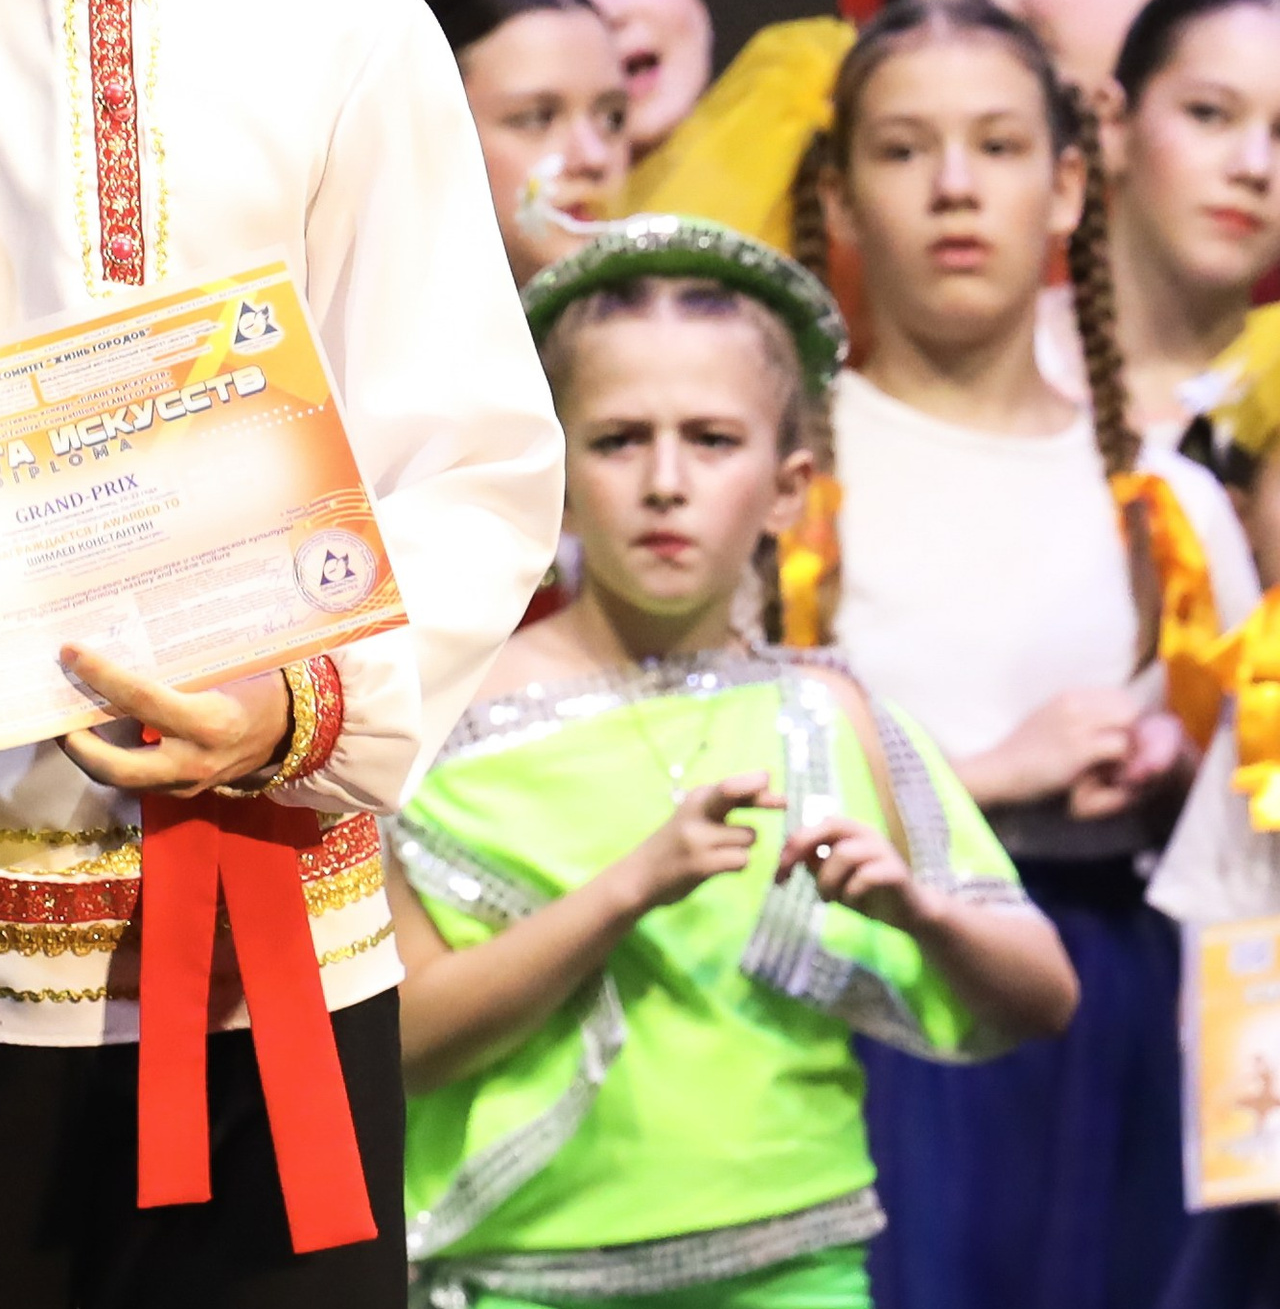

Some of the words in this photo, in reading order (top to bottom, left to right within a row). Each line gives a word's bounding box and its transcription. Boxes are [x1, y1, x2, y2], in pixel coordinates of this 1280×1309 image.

[46, 365, 267, 456] ИСКУССТВ
[15, 473, 139, 524] GRAND-PRIX
[102, 505, 160, 531] AWARDED
[164, 497, 180, 511] TO
[78, 520, 154, 552] КОНСТАНТИН
[157, 564, 172, 579] and
